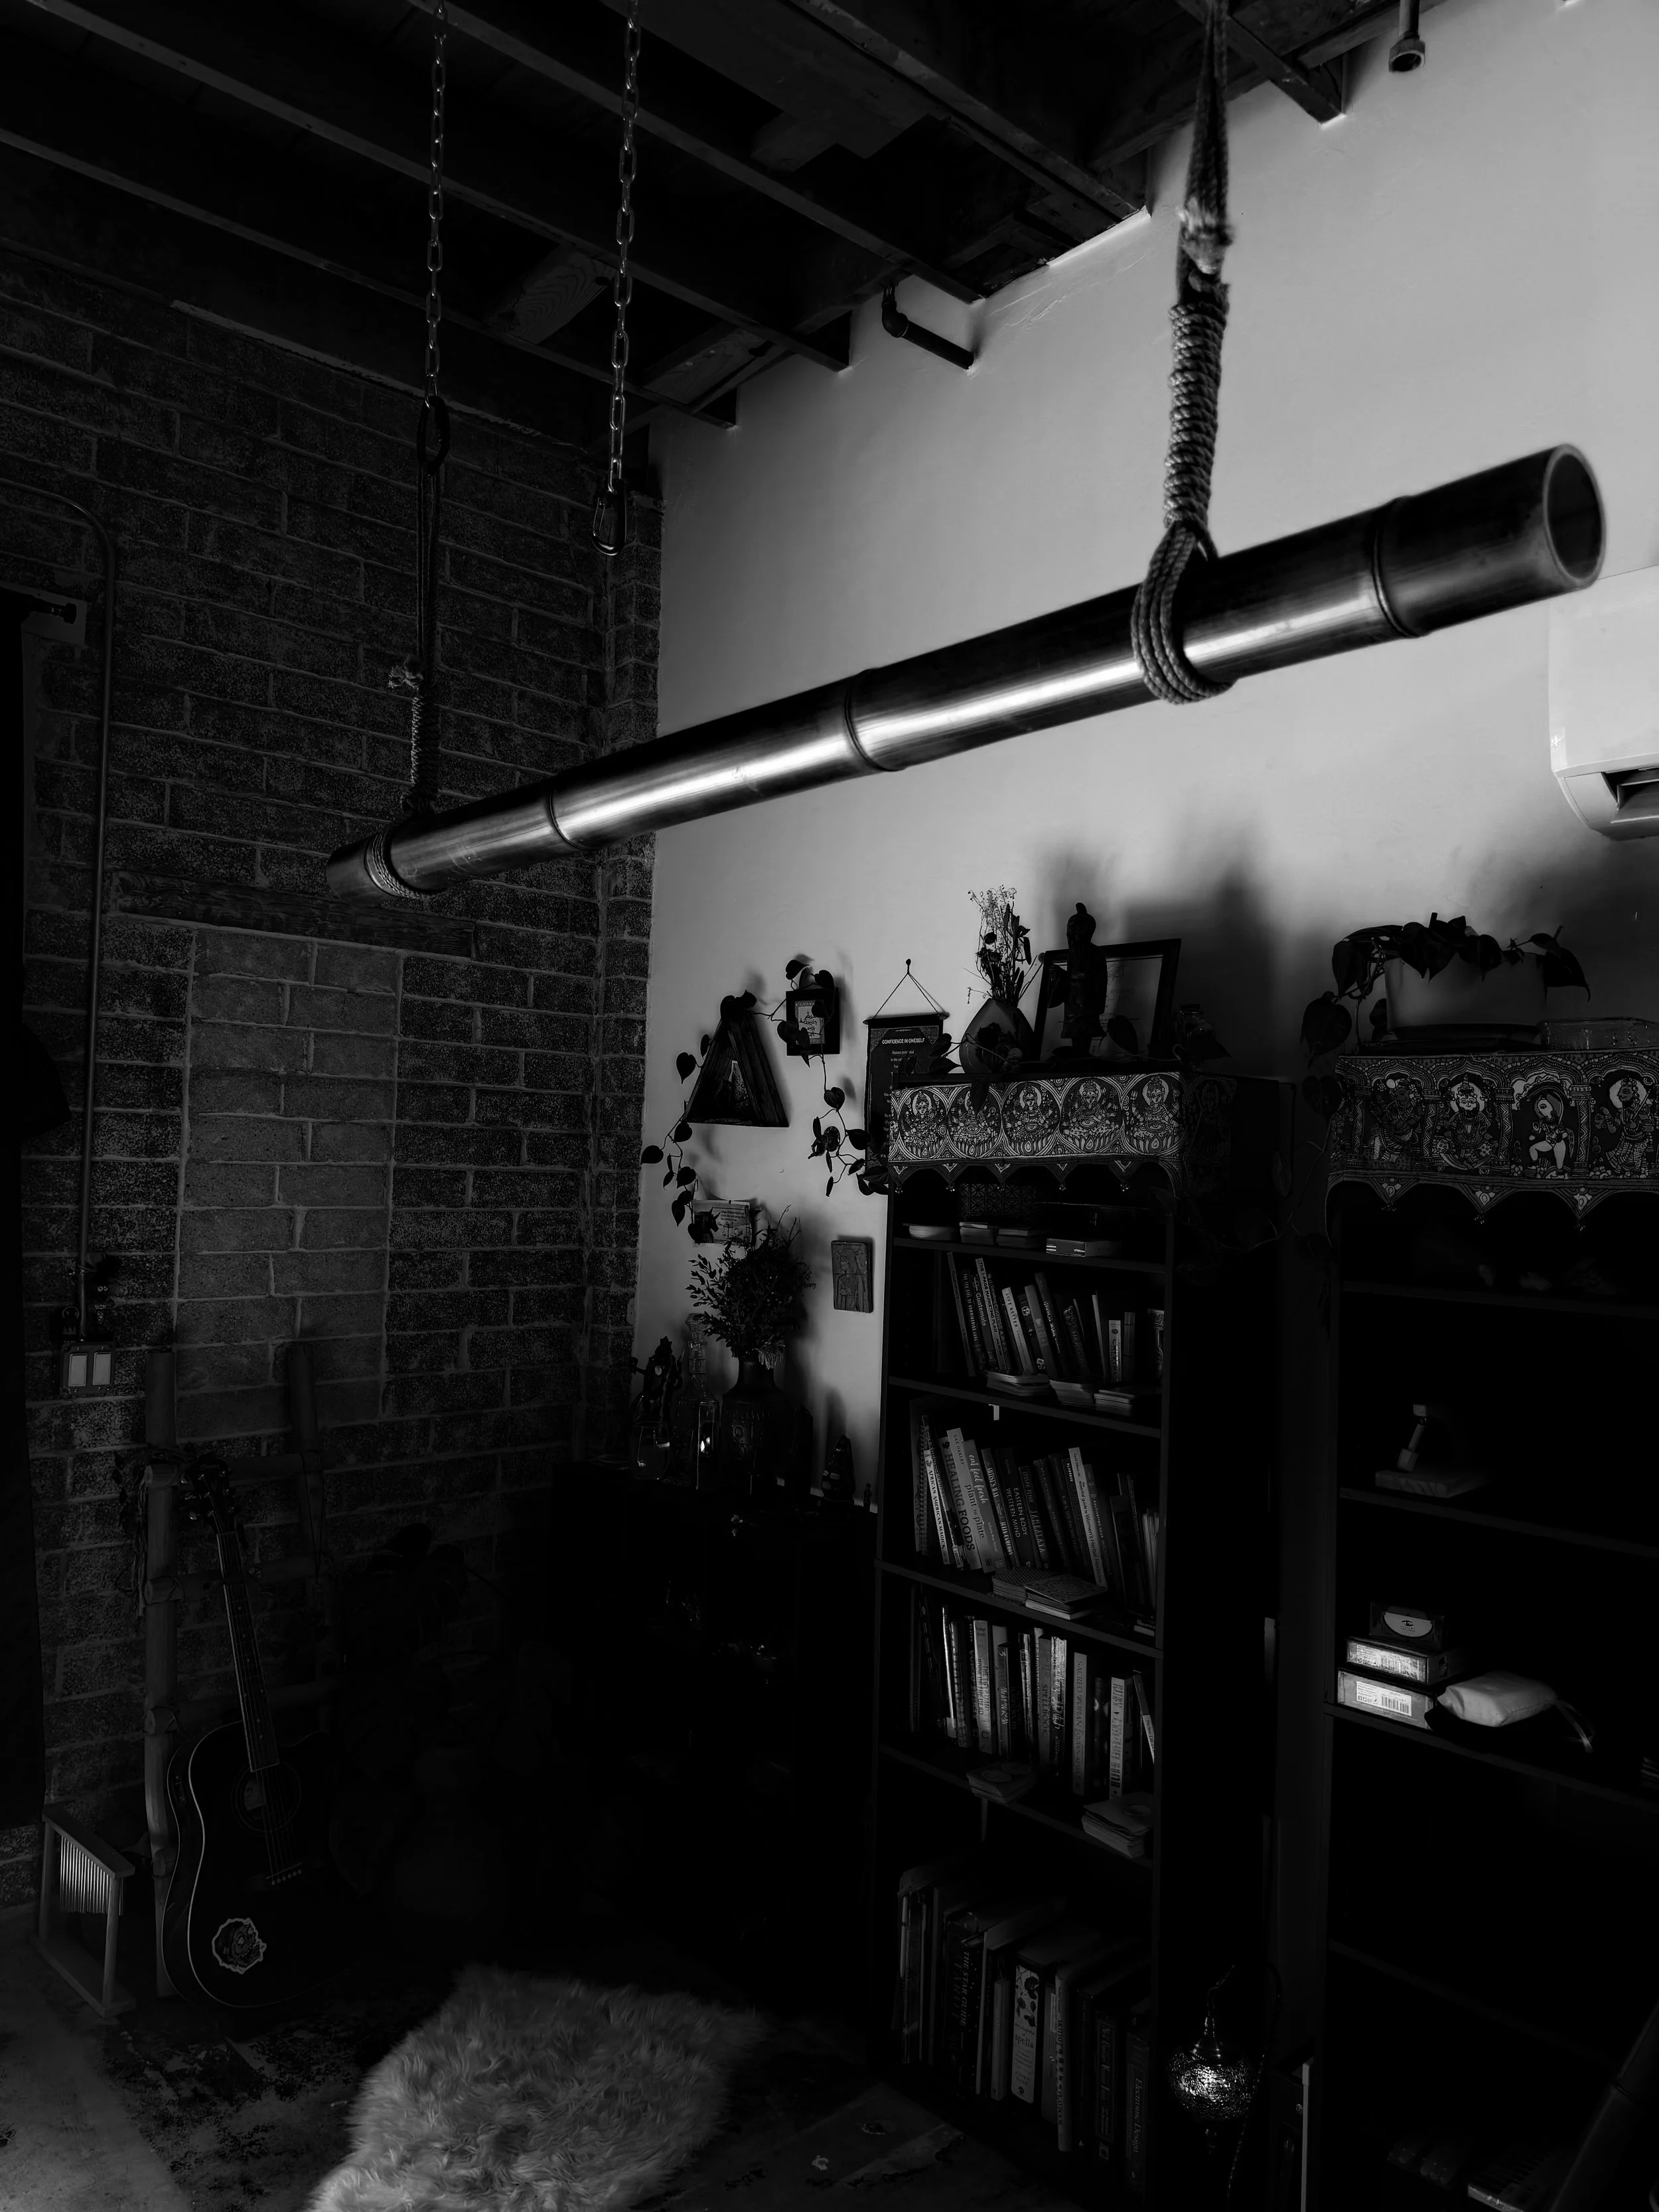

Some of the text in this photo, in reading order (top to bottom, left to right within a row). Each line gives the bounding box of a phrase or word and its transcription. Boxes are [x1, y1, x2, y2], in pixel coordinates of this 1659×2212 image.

[975, 1293, 987, 1326] Guatemala
[1009, 1307, 1017, 1327] BETTER
[928, 1469, 937, 1494] AFRICAN
[968, 1453, 988, 1505] eat feel fresh
[932, 1495, 942, 1524] AMERICAN
[944, 1453, 975, 1551] HEALING FOODS
[964, 1483, 978, 1507] plant
[972, 1515, 986, 1539] plate
[1005, 1487, 1021, 1538] WESTERN MIND
[1013, 1487, 1029, 1536] EASTERN BODY
[938, 1526, 946, 1548] MAGICK
[1029, 1509, 1046, 1553] JAMBALAYA
[1084, 1513, 1095, 1538] Women's
[1090, 1539, 1098, 1557] Herbal
[1093, 1558, 1104, 1584] Medicine
[1015, 2033, 1034, 2048] spells
[1131, 2078, 1142, 2153] Electronic Design
